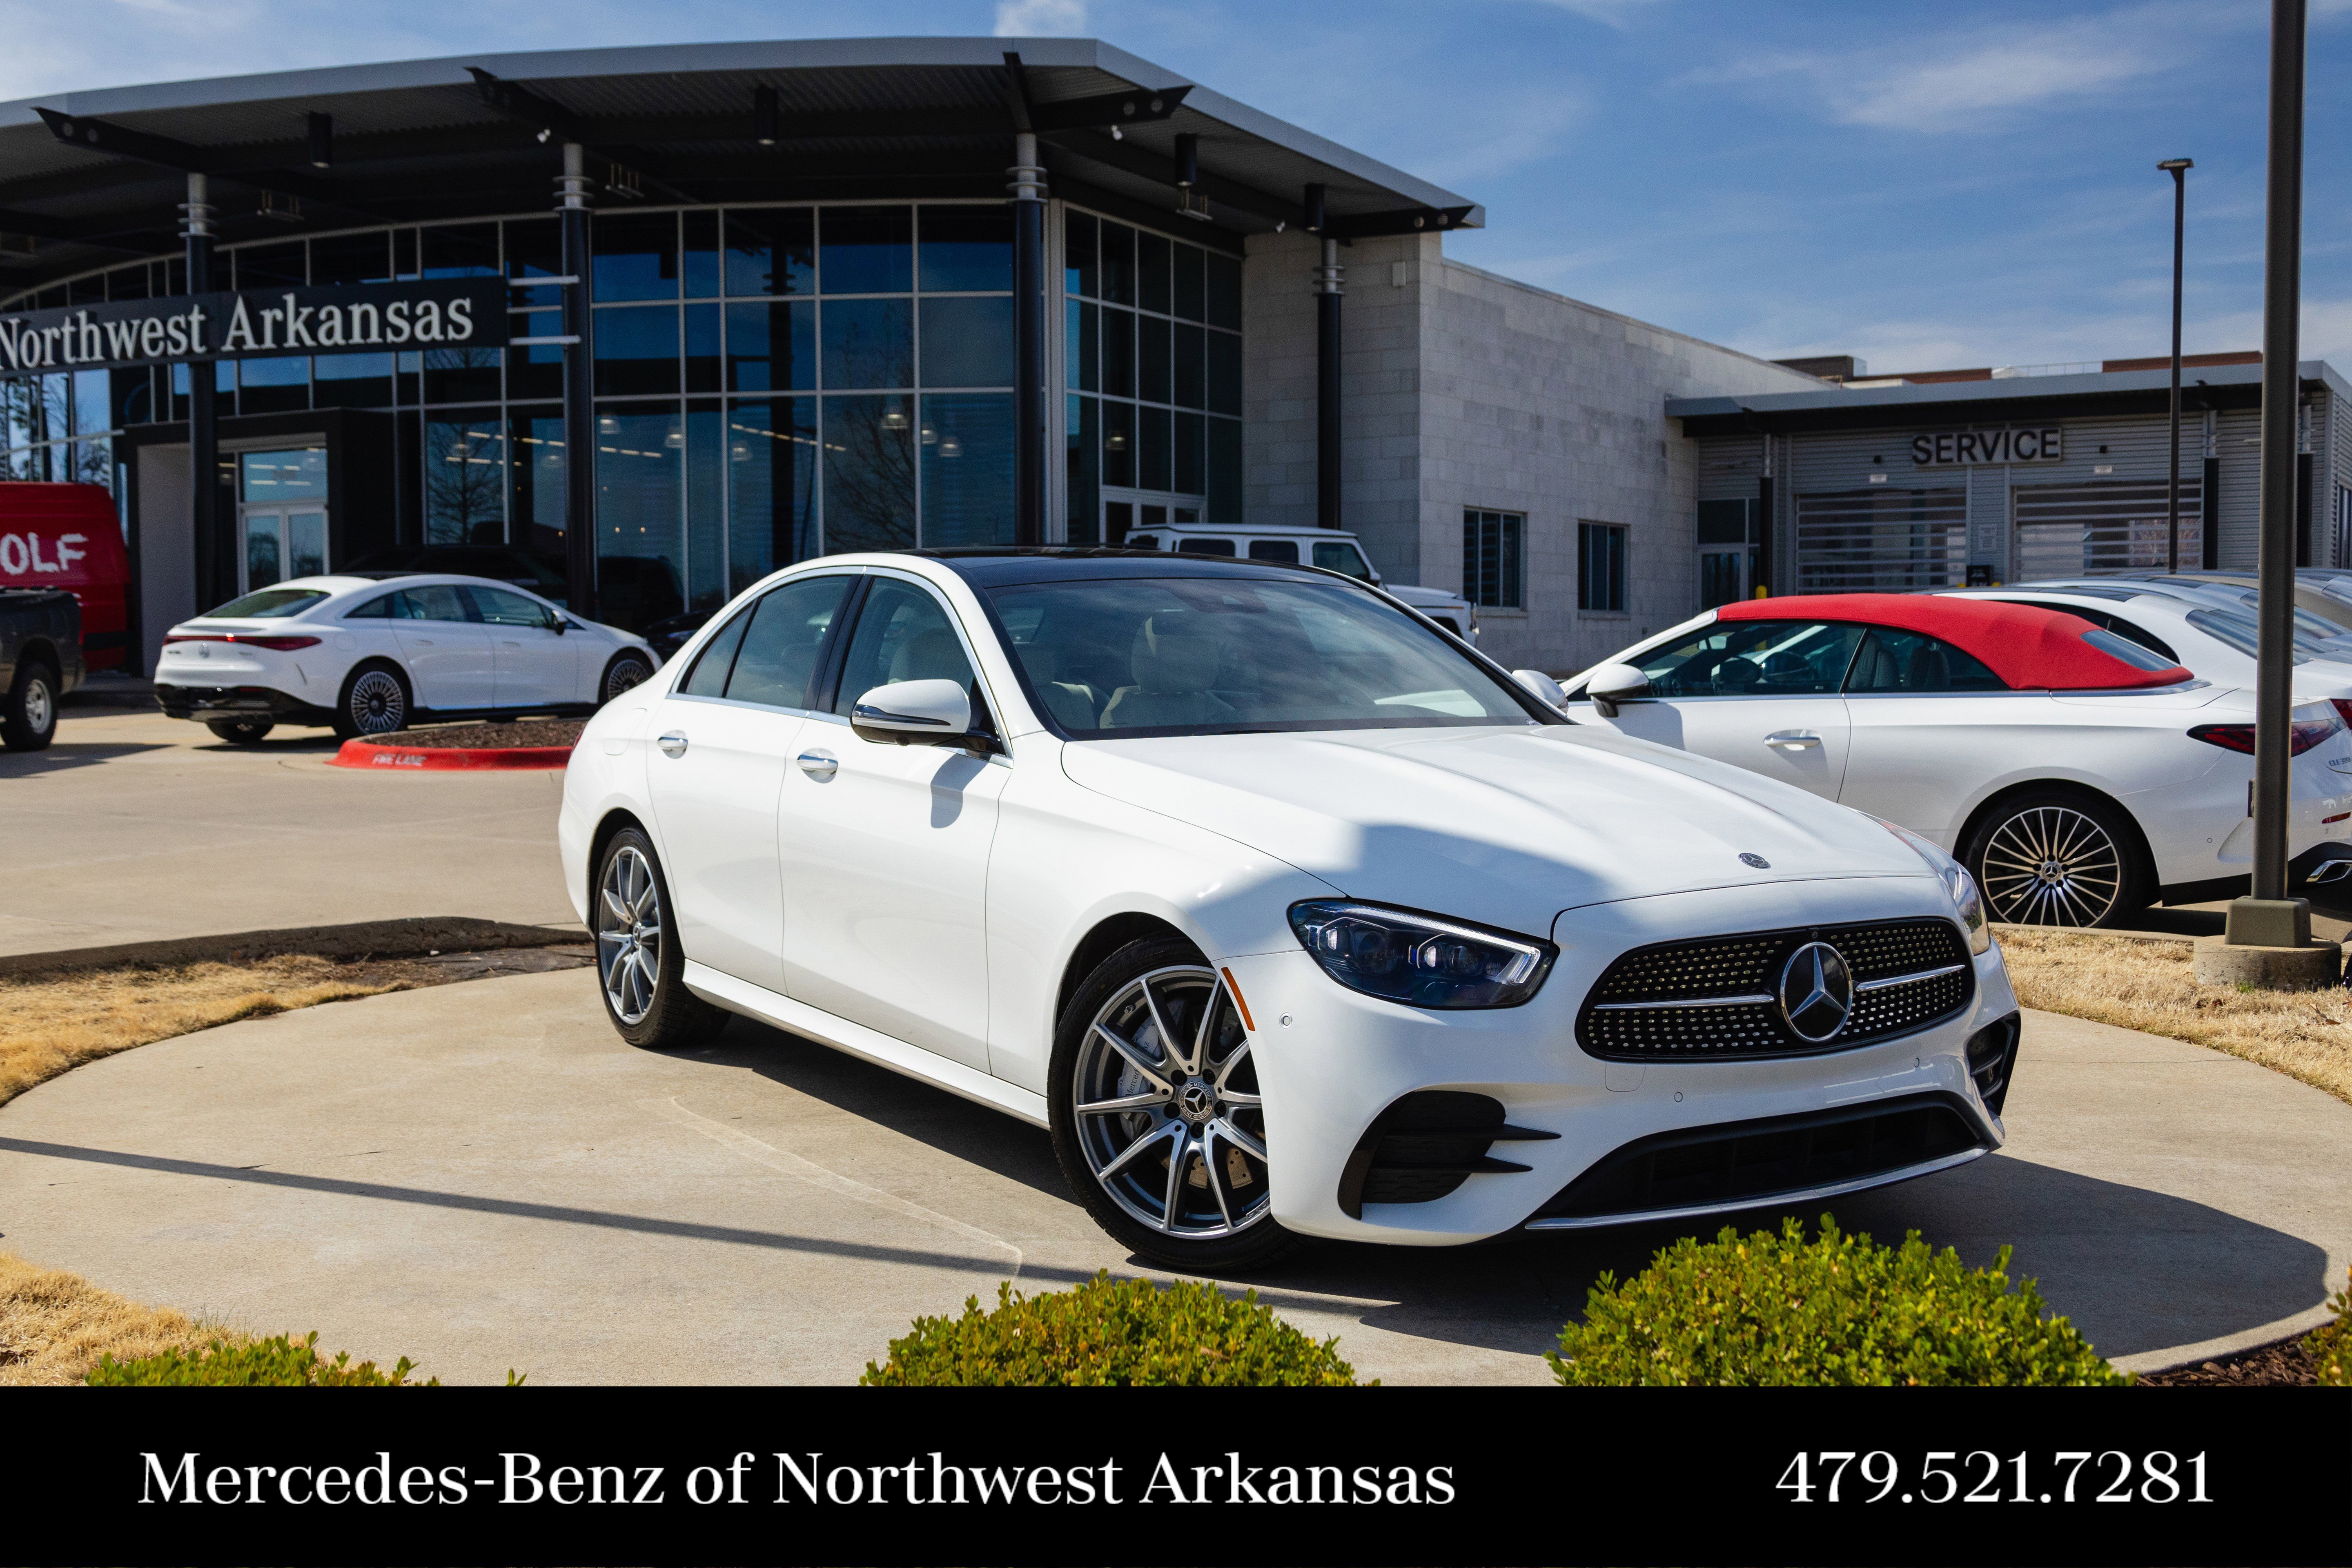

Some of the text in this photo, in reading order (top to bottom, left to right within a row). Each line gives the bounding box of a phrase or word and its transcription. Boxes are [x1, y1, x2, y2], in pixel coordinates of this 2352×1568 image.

[0, 292, 474, 370] Northwest Arkansas
[1911, 429, 2059, 465] SERVICE
[1194, 1082, 1212, 1101] MERCEDES
[1182, 1107, 1192, 1118] BENZ
